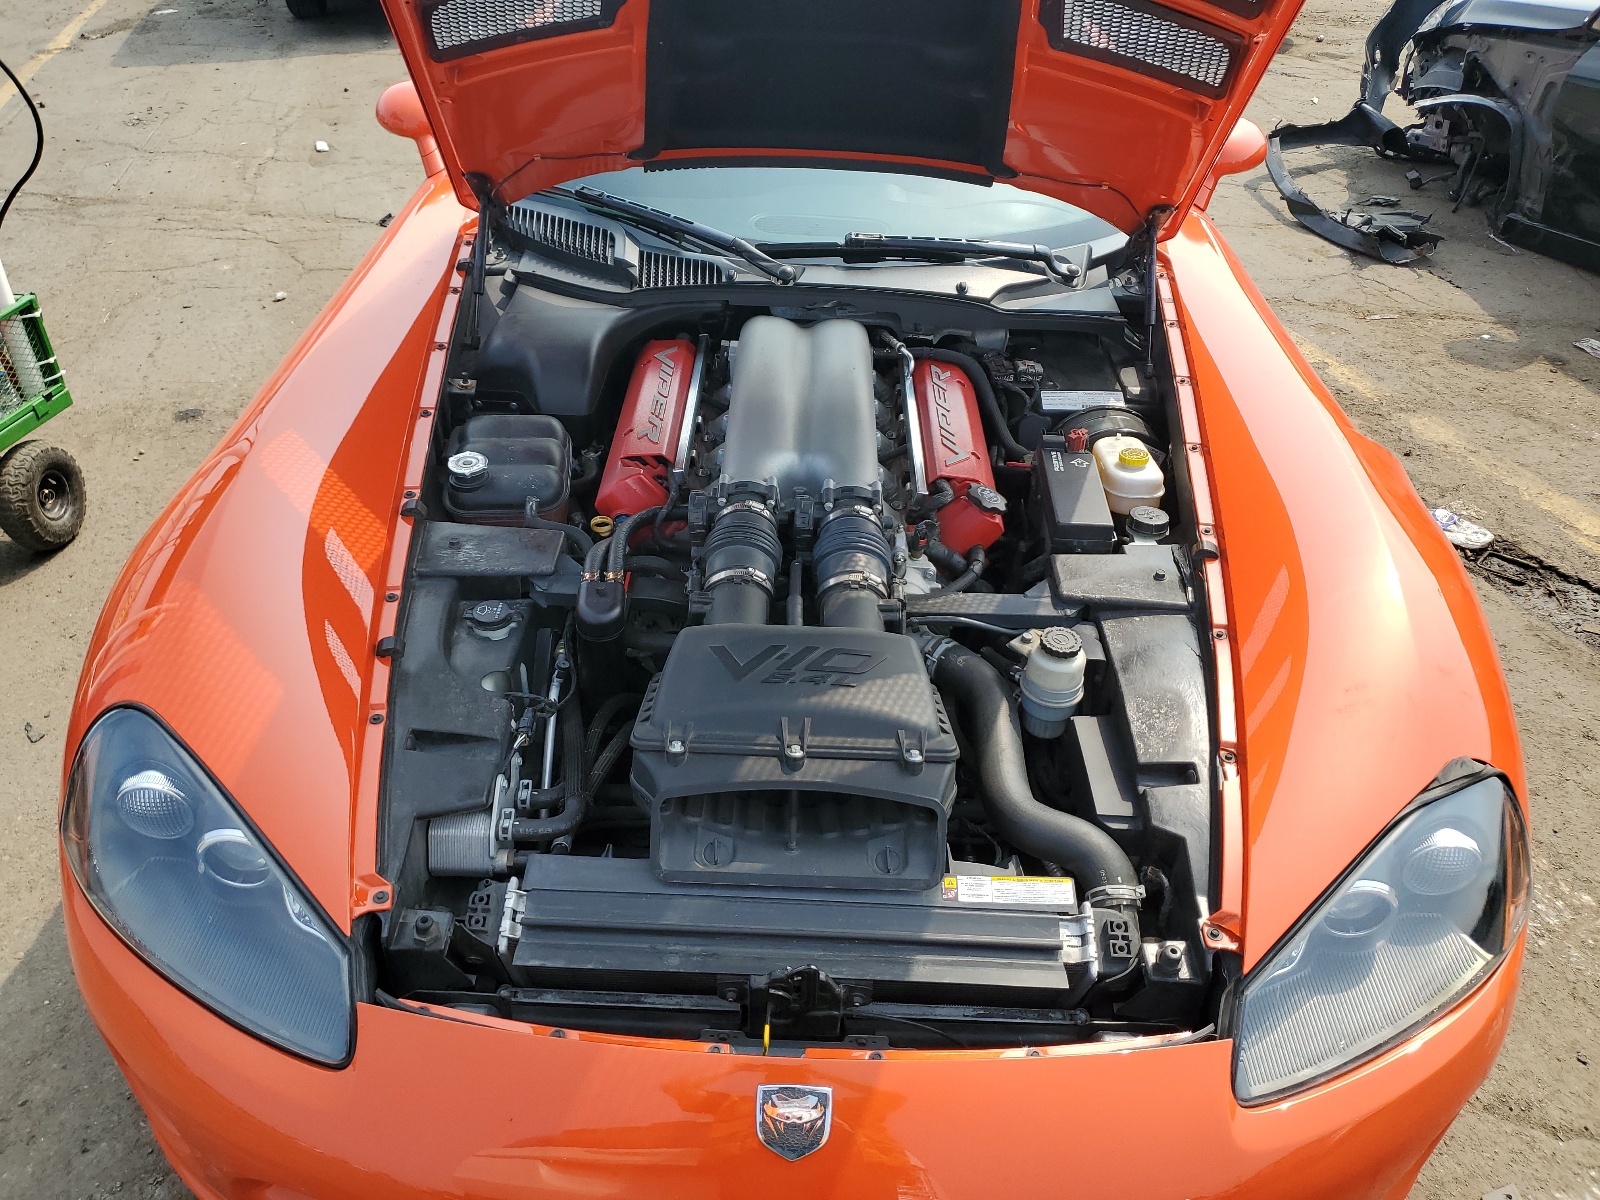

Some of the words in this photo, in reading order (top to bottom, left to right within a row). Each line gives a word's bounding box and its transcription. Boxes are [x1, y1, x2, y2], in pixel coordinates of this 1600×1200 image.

[636, 345, 679, 444] VIPER
[930, 364, 971, 467] VIPER
[760, 671, 857, 688] 8.4L
